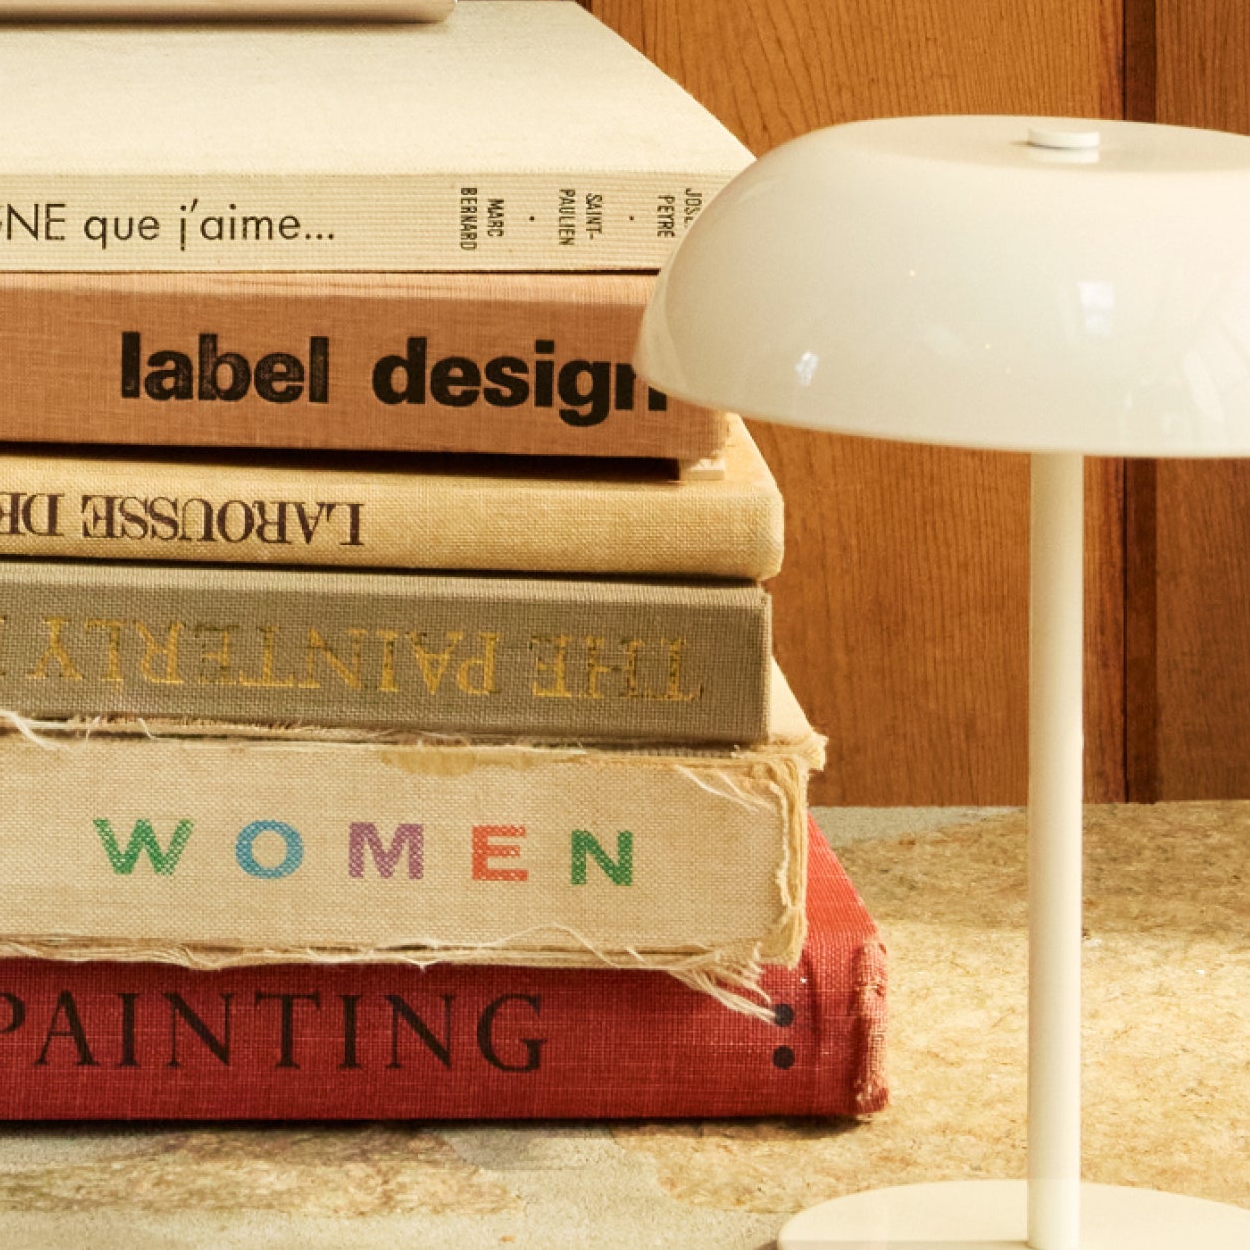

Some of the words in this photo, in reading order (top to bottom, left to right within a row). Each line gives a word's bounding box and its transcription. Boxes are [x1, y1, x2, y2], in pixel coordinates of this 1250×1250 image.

[83, 215, 160, 250] que
[180, 198, 334, 252] j'aime...
[460, 187, 478, 251] BERNARD
[487, 198, 505, 237] MARC
[558, 188, 576, 246] PAULIEN
[585, 193, 603, 240] SAINT-
[121, 330, 330, 404] label
[371, 336, 668, 428] design
[80, 493, 366, 546] LAROUSSE
[26, 616, 503, 695] PAINTERLY
[530, 632, 703, 701] THE
[92, 818, 635, 887] WOMEN
